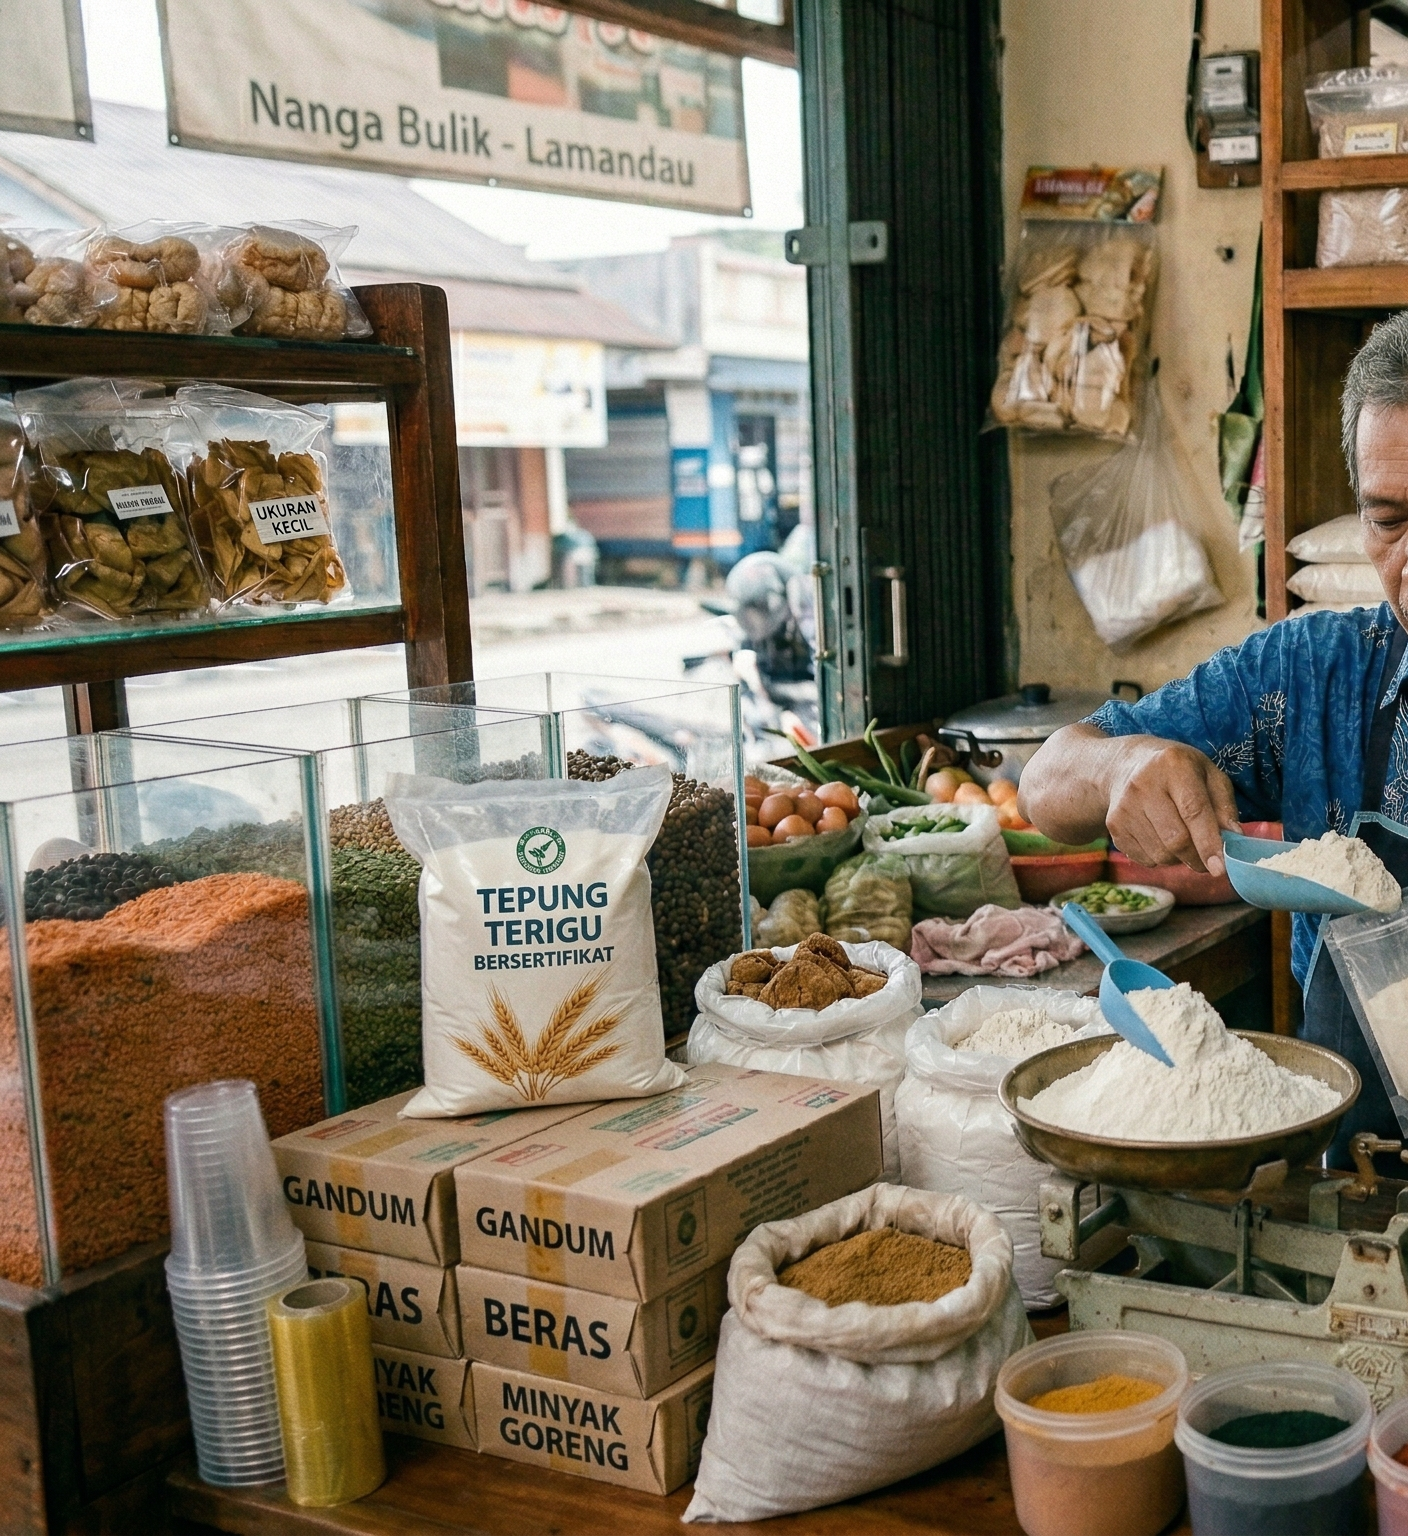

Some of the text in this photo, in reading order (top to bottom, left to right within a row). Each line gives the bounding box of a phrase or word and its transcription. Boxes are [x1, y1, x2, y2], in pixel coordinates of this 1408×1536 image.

[250, 80, 384, 152] Nanga
[398, 105, 492, 158] Bulik
[525, 126, 696, 188] Lamandau
[256, 500, 317, 520] UKURAN
[272, 519, 314, 535] KECIL
[476, 882, 608, 914] TEPUNG
[484, 914, 602, 947] TERIGU
[474, 946, 615, 971] BERSERTIFIKAT
[283, 1175, 417, 1227] GANDUM
[476, 1207, 615, 1260] GANDUM
[485, 1297, 612, 1360] BERAS
[502, 1382, 623, 1436] MINYAK
[500, 1417, 629, 1472] GORENG
